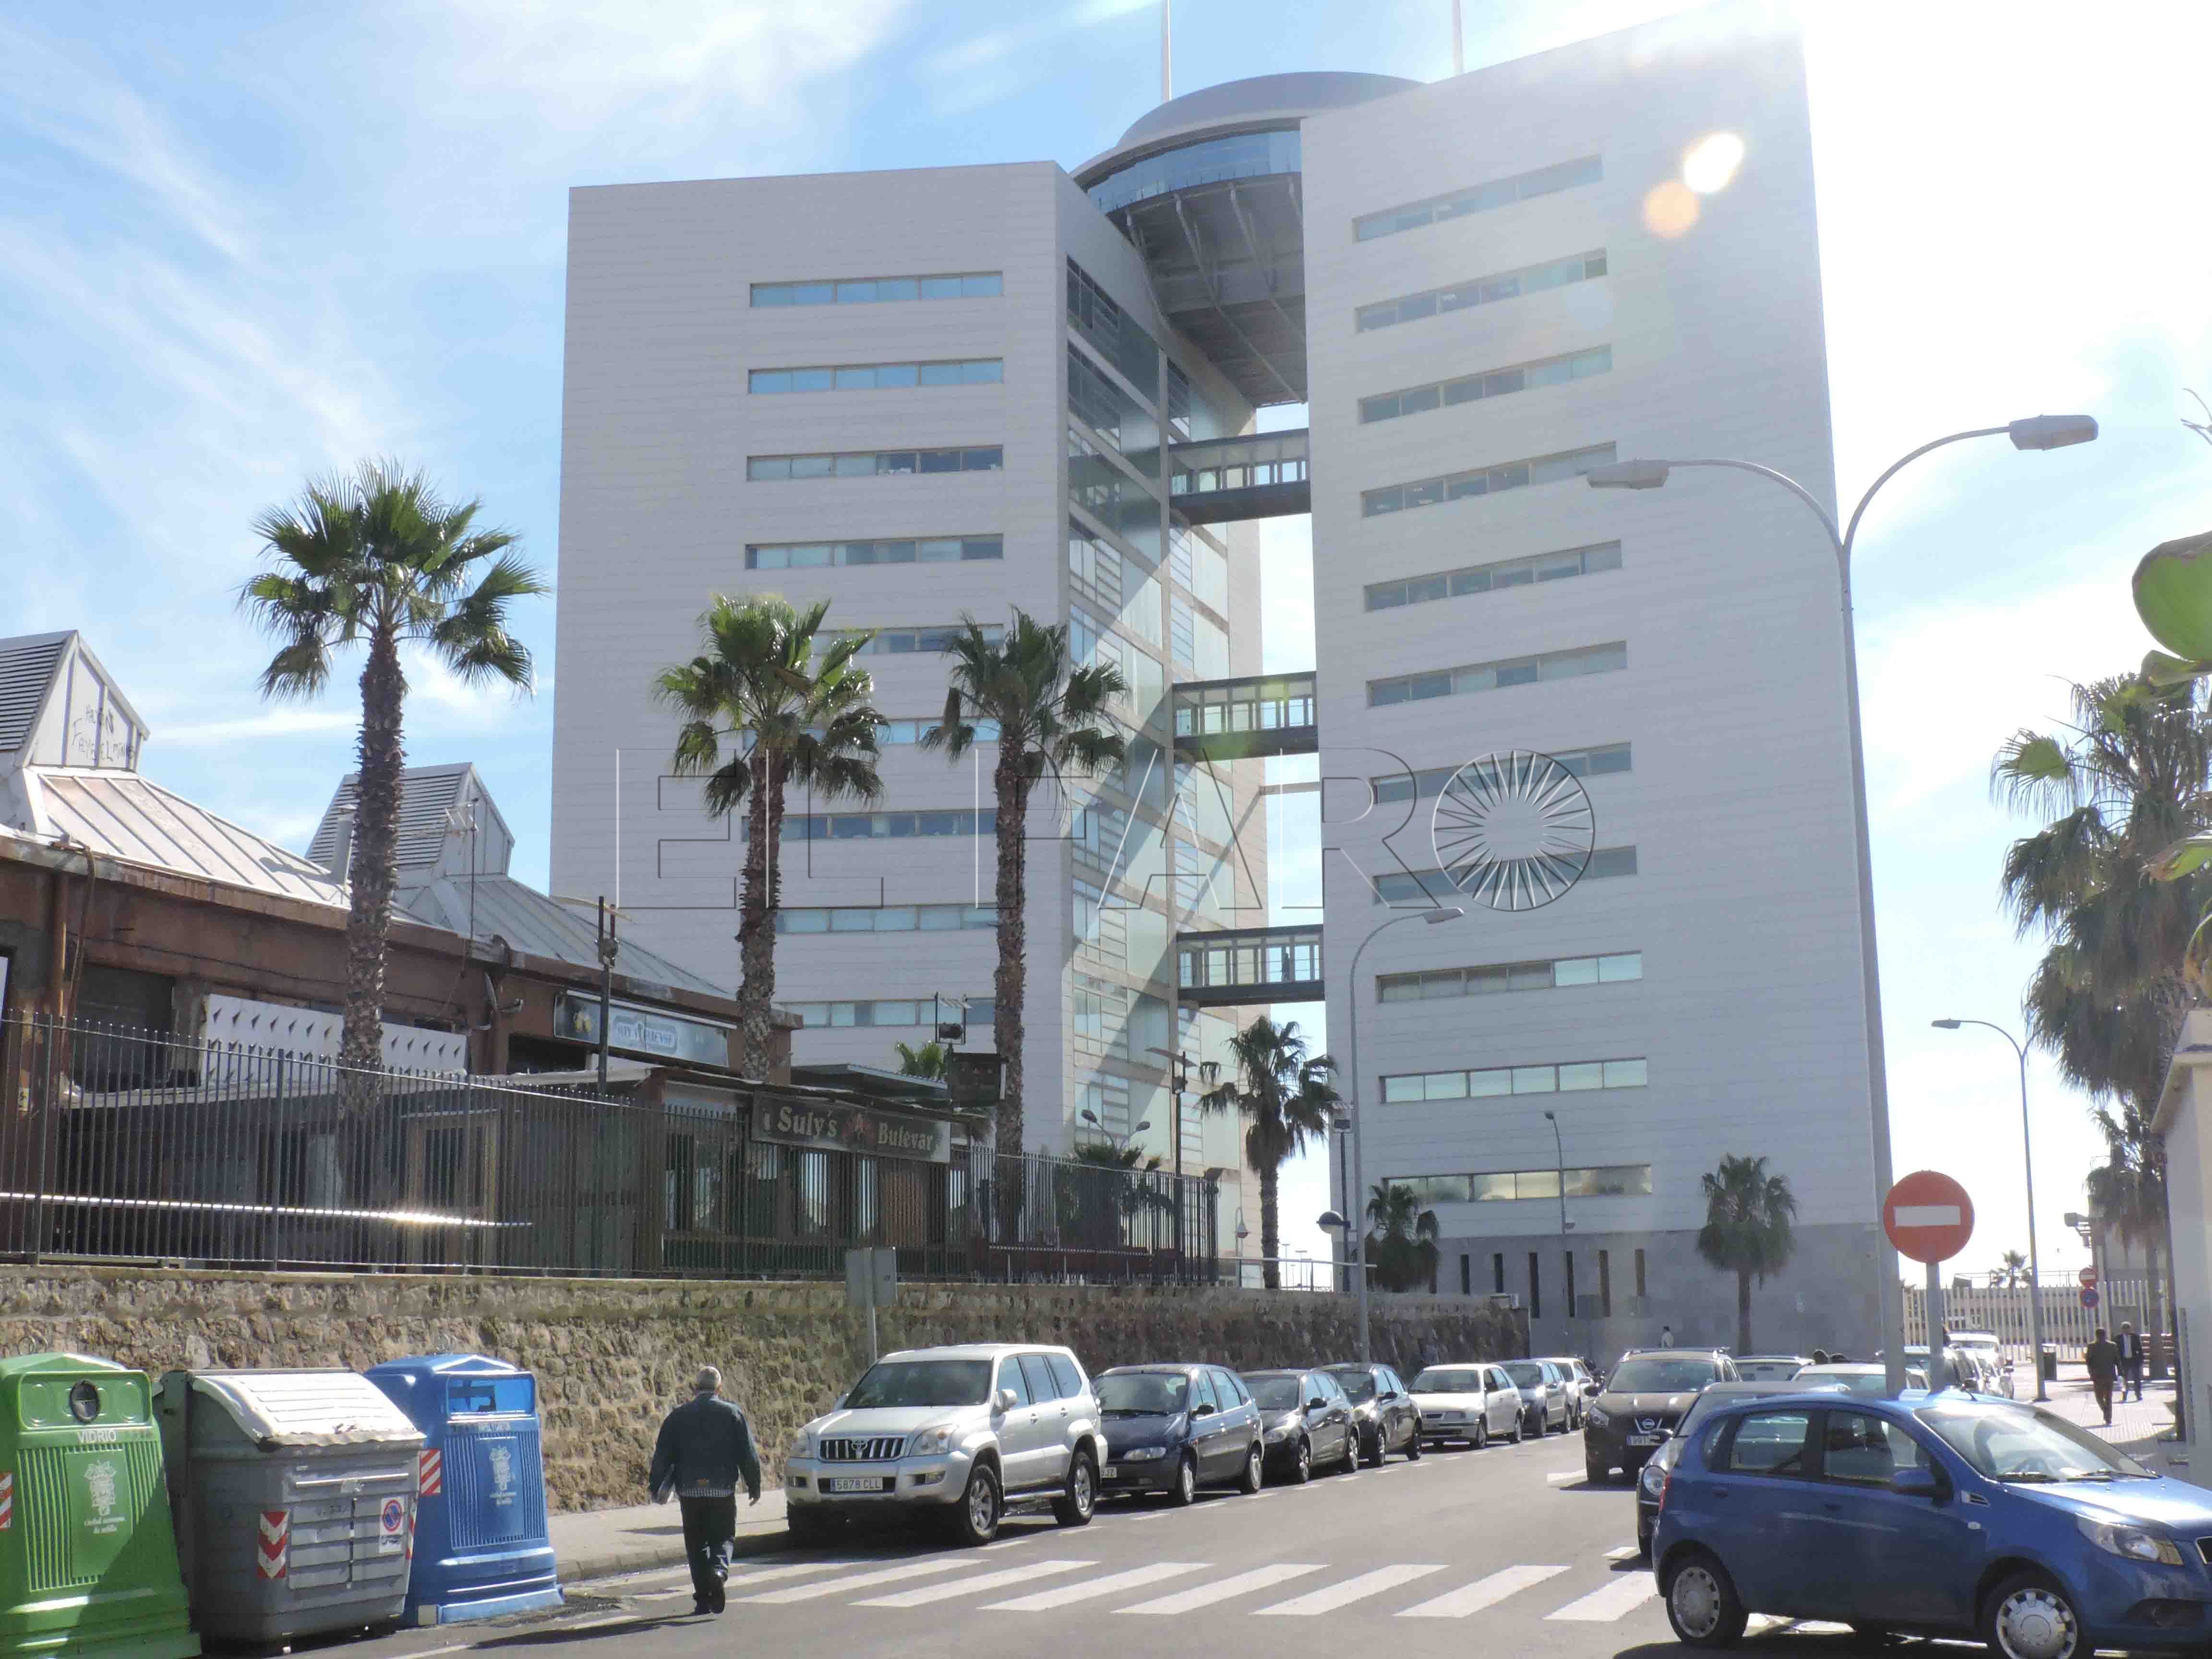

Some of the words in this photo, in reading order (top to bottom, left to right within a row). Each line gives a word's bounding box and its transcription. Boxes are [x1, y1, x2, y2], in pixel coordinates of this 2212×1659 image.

[777, 1106, 838, 1139] Suly's
[878, 1121, 934, 1151] Bulevar
[77, 1429, 116, 1443] VIDRIO
